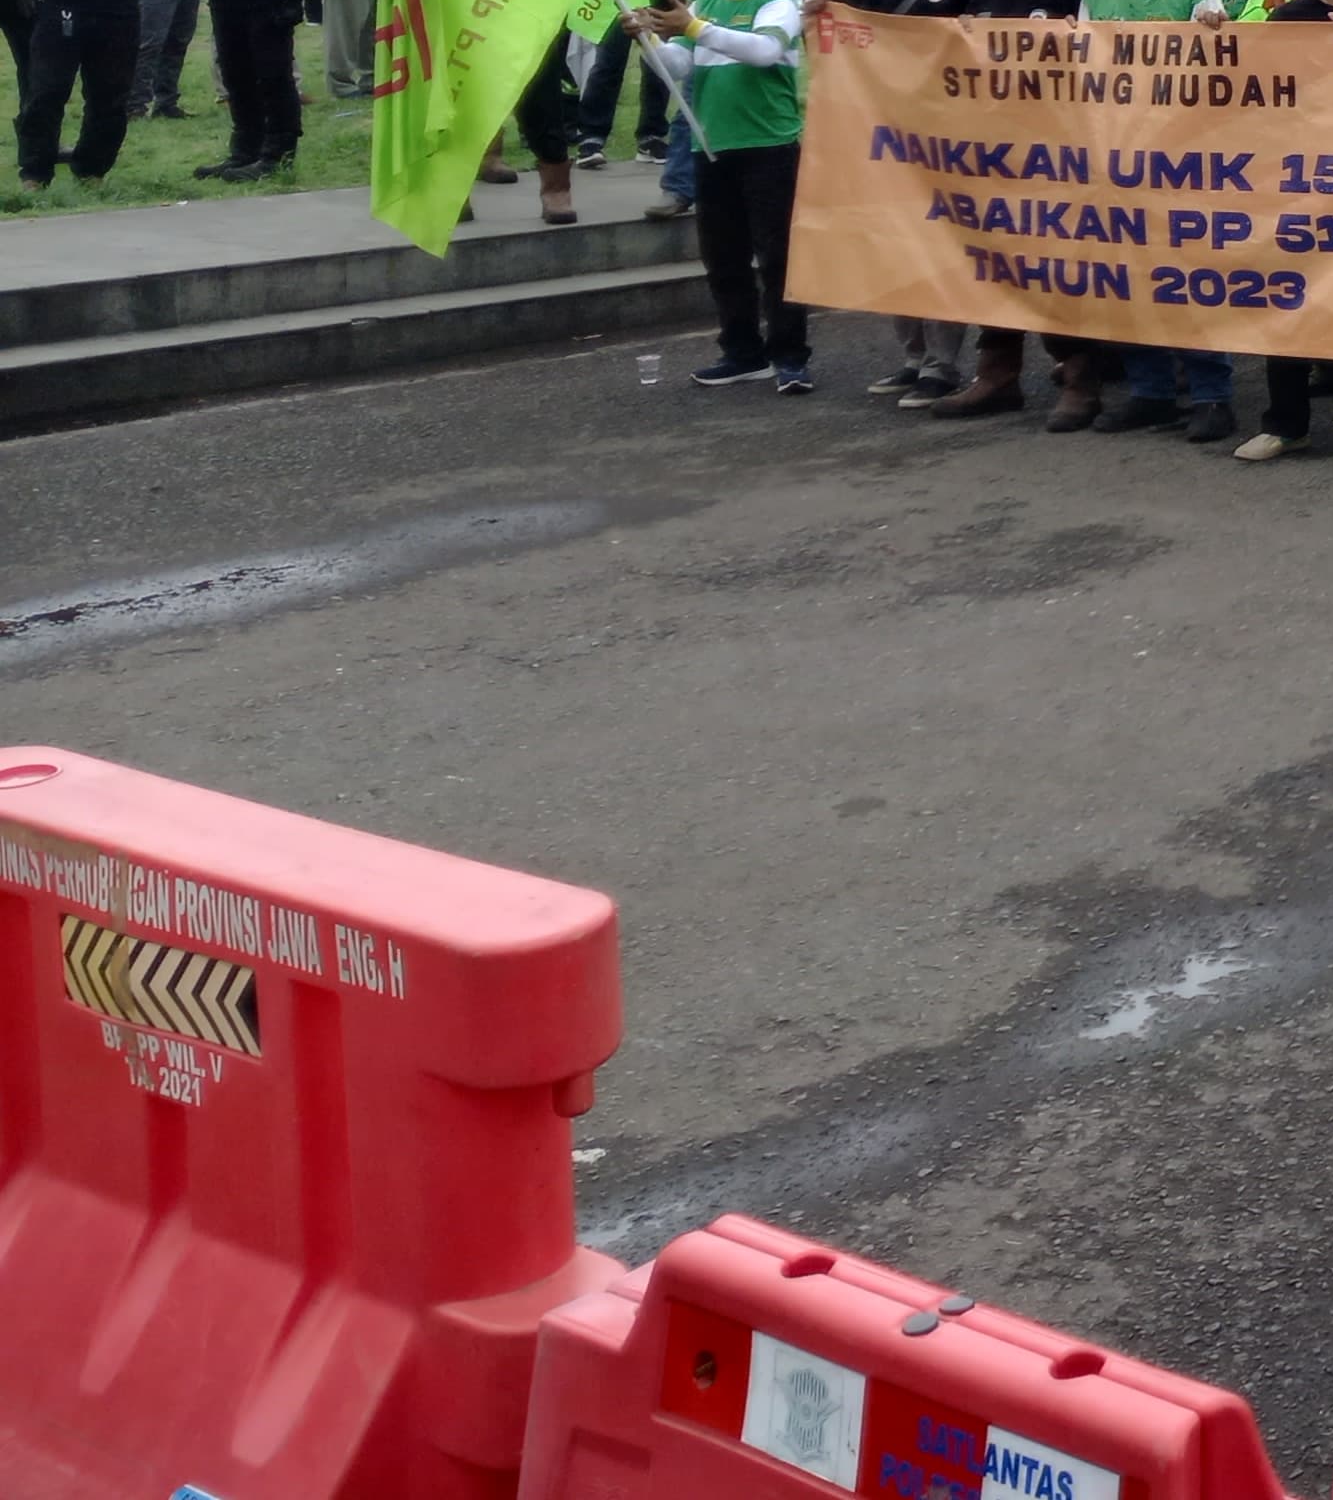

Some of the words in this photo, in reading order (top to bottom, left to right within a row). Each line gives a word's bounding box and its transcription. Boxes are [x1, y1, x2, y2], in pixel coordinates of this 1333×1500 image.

[988, 31, 1090, 64] UPAH
[1113, 32, 1239, 67] MURAH
[943, 66, 1134, 106] STUNTING
[1151, 72, 1297, 109] MUDAH
[869, 124, 1089, 185] NAIKKAN
[1108, 148, 1254, 192] UMK
[925, 188, 1148, 247] ABAIKAN
[1169, 208, 1252, 251] PP
[965, 245, 1131, 301] TAHUN
[1151, 265, 1307, 311] 2023
[175, 876, 263, 959] PROVINSI
[268, 904, 323, 976] JAWA
[335, 923, 404, 1000] ENGH
[158, 1066, 201, 1107] 2021
[164, 1038, 206, 1078] WIL.
[208, 1051, 223, 1083] V
[918, 1414, 1073, 1500] SATLANTAS
